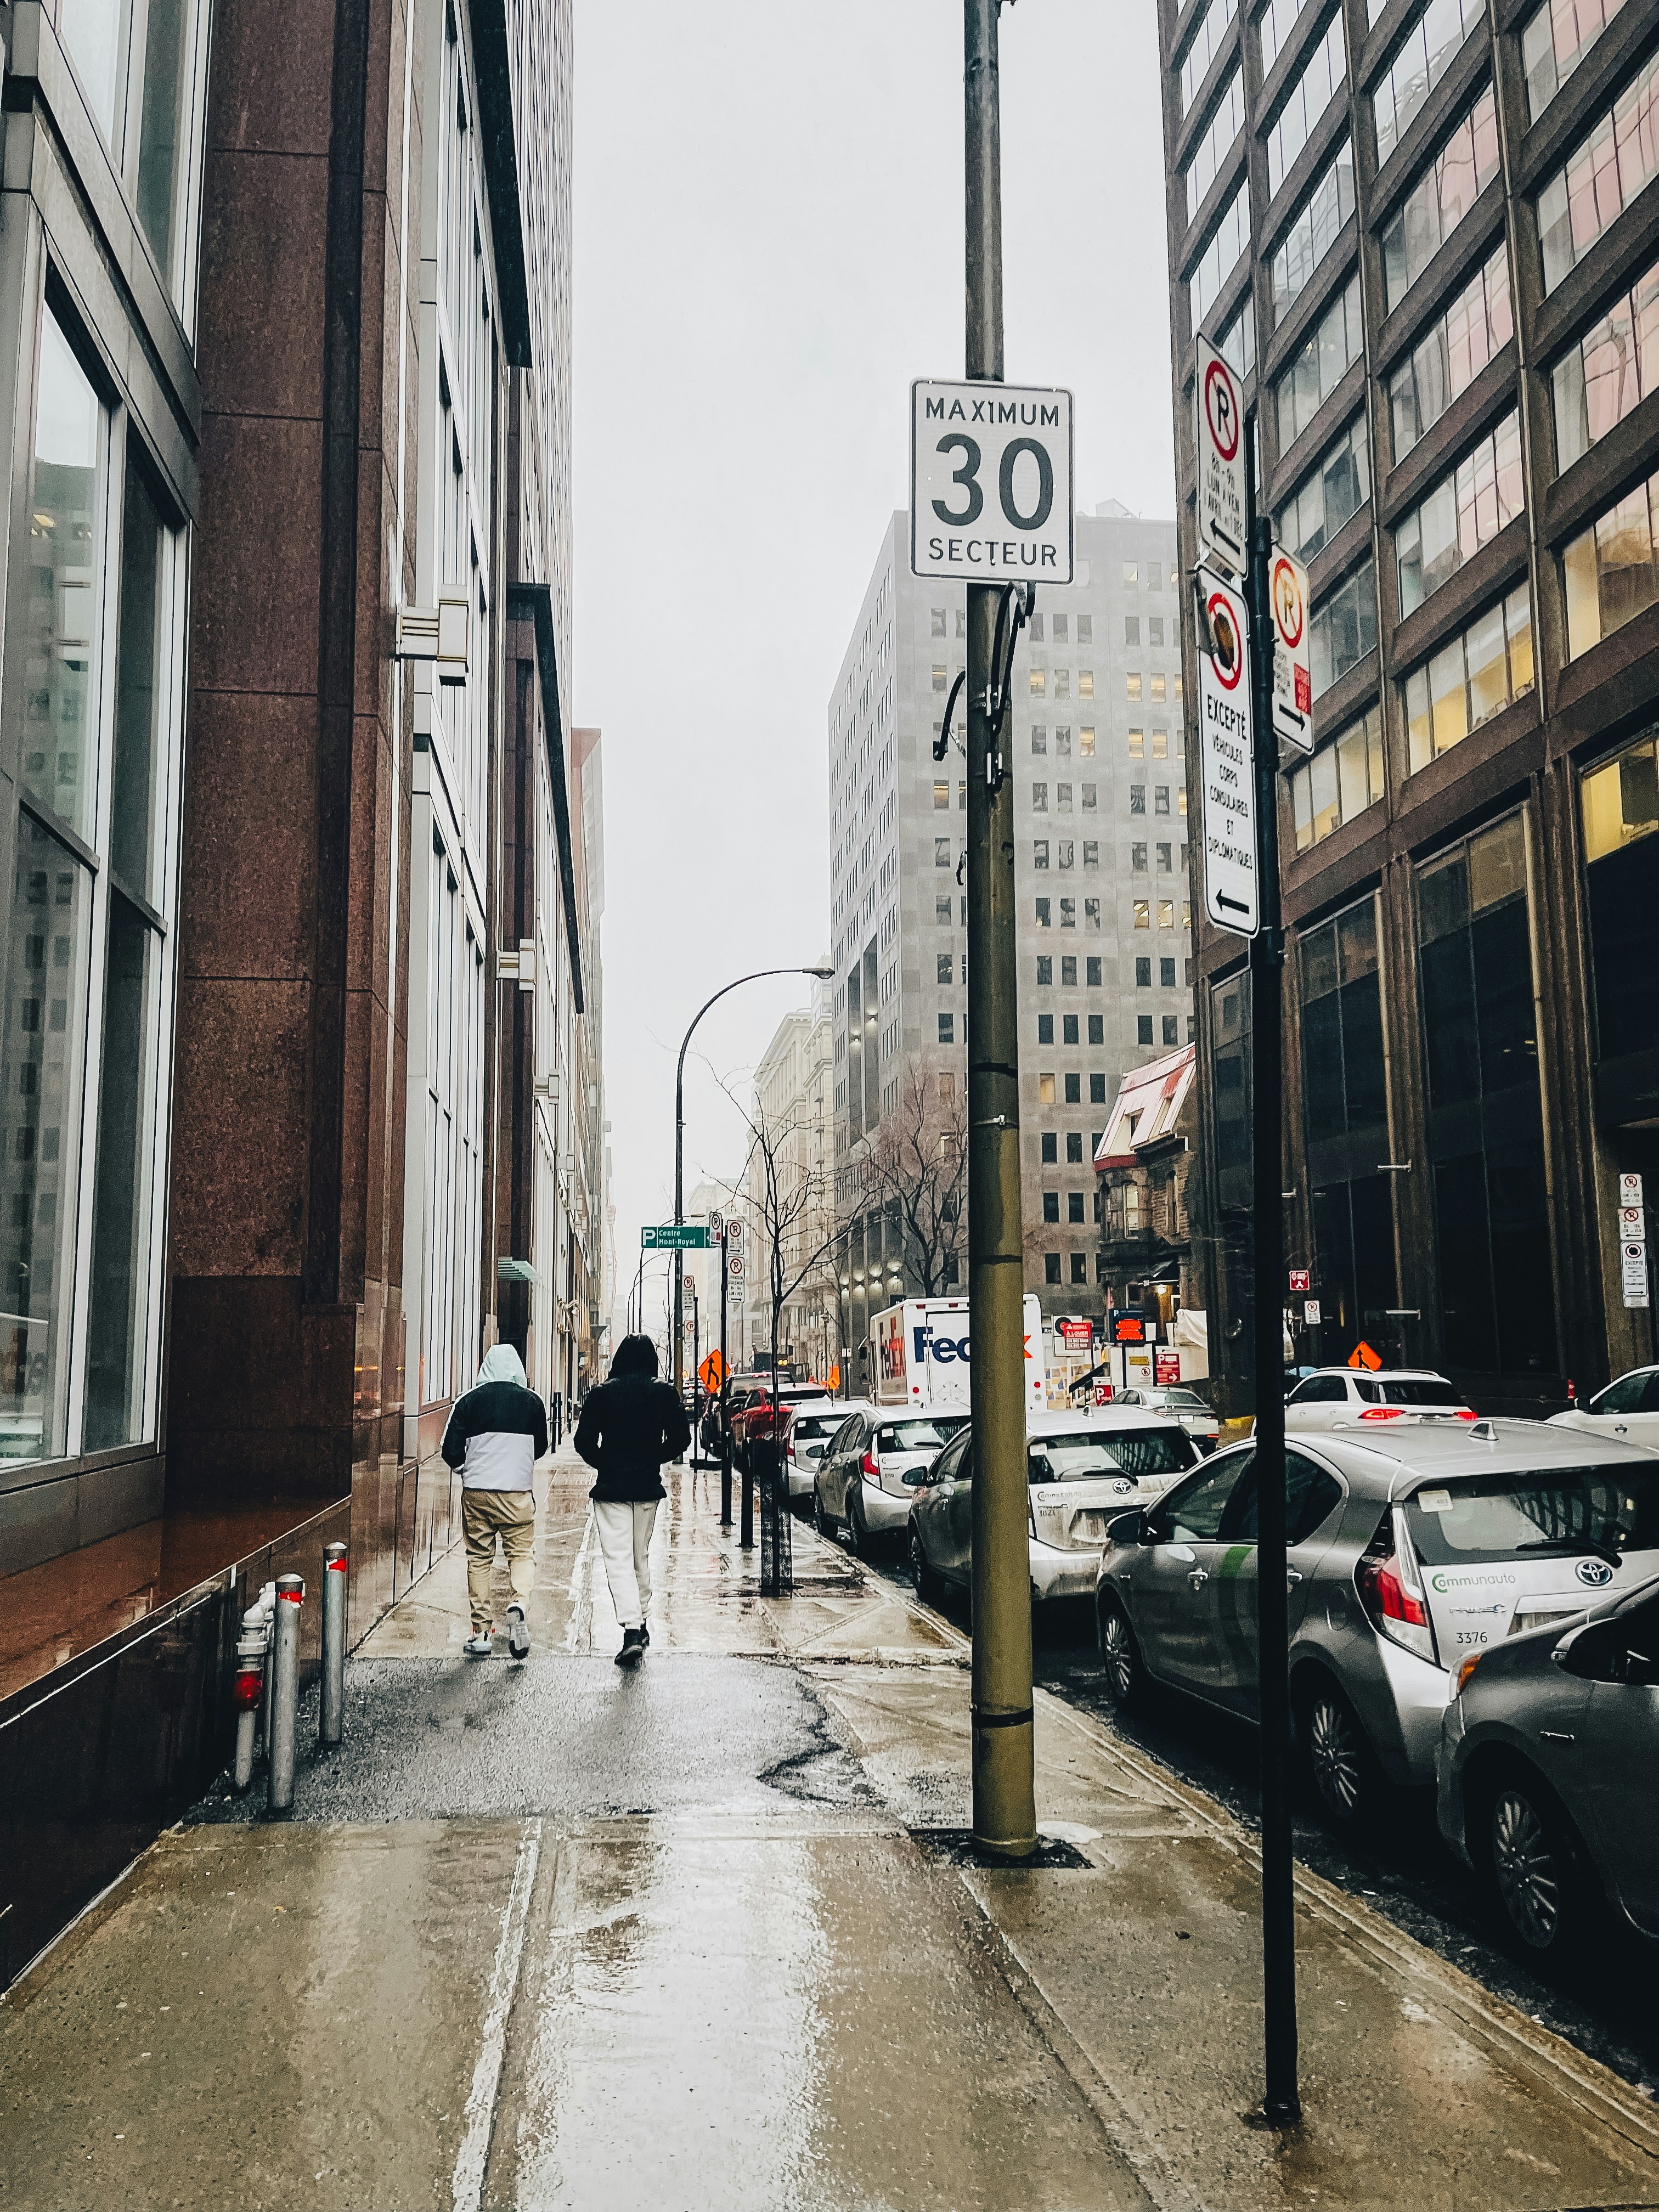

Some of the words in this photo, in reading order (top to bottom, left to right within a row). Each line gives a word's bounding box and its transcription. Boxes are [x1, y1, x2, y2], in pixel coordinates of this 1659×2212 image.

[926, 397, 1059, 427] MAXIMUM
[931, 433, 1053, 531] 30
[928, 537, 1057, 567] SECTEUR
[1207, 693, 1247, 741] EXCEPTÉ
[642, 1229, 656, 1246] P
[1158, 1355, 1165, 1365] P
[1096, 1387, 1104, 1401] P
[1037, 1491, 1082, 1502] Communauto
[1432, 1573, 1516, 1593] Communauto
[1456, 1632, 1488, 1644] 3376
